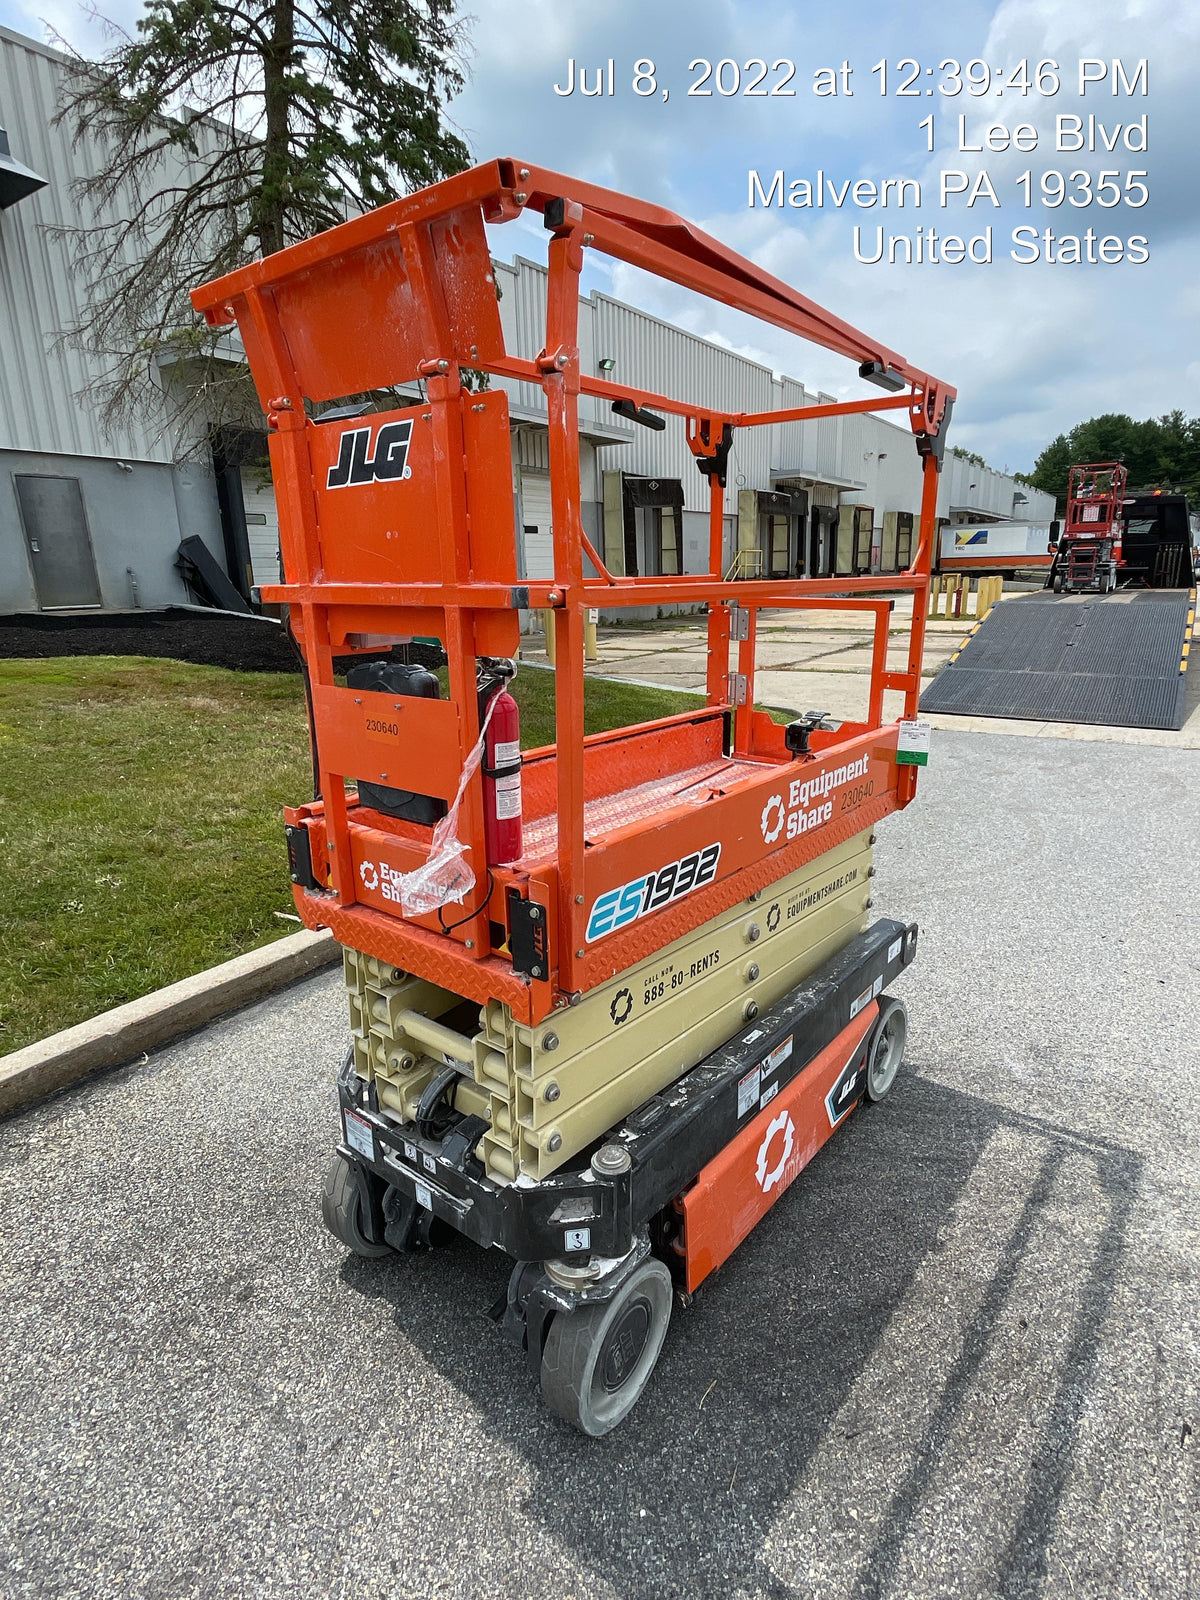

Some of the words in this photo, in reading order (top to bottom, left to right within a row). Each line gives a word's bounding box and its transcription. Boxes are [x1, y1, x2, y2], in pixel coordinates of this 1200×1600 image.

[326, 419, 414, 490] JLG
[366, 718, 399, 736] 230640
[787, 752, 870, 809] Equipment
[840, 780, 874, 811] 230640
[786, 800, 833, 840] Share
[585, 841, 722, 944] ES1932
[787, 868, 858, 919] EQUIPMENTSHARE.COM
[643, 949, 720, 1005] 888-80-RENTS
[644, 974, 659, 986] CALL
[661, 965, 674, 977] NOW
